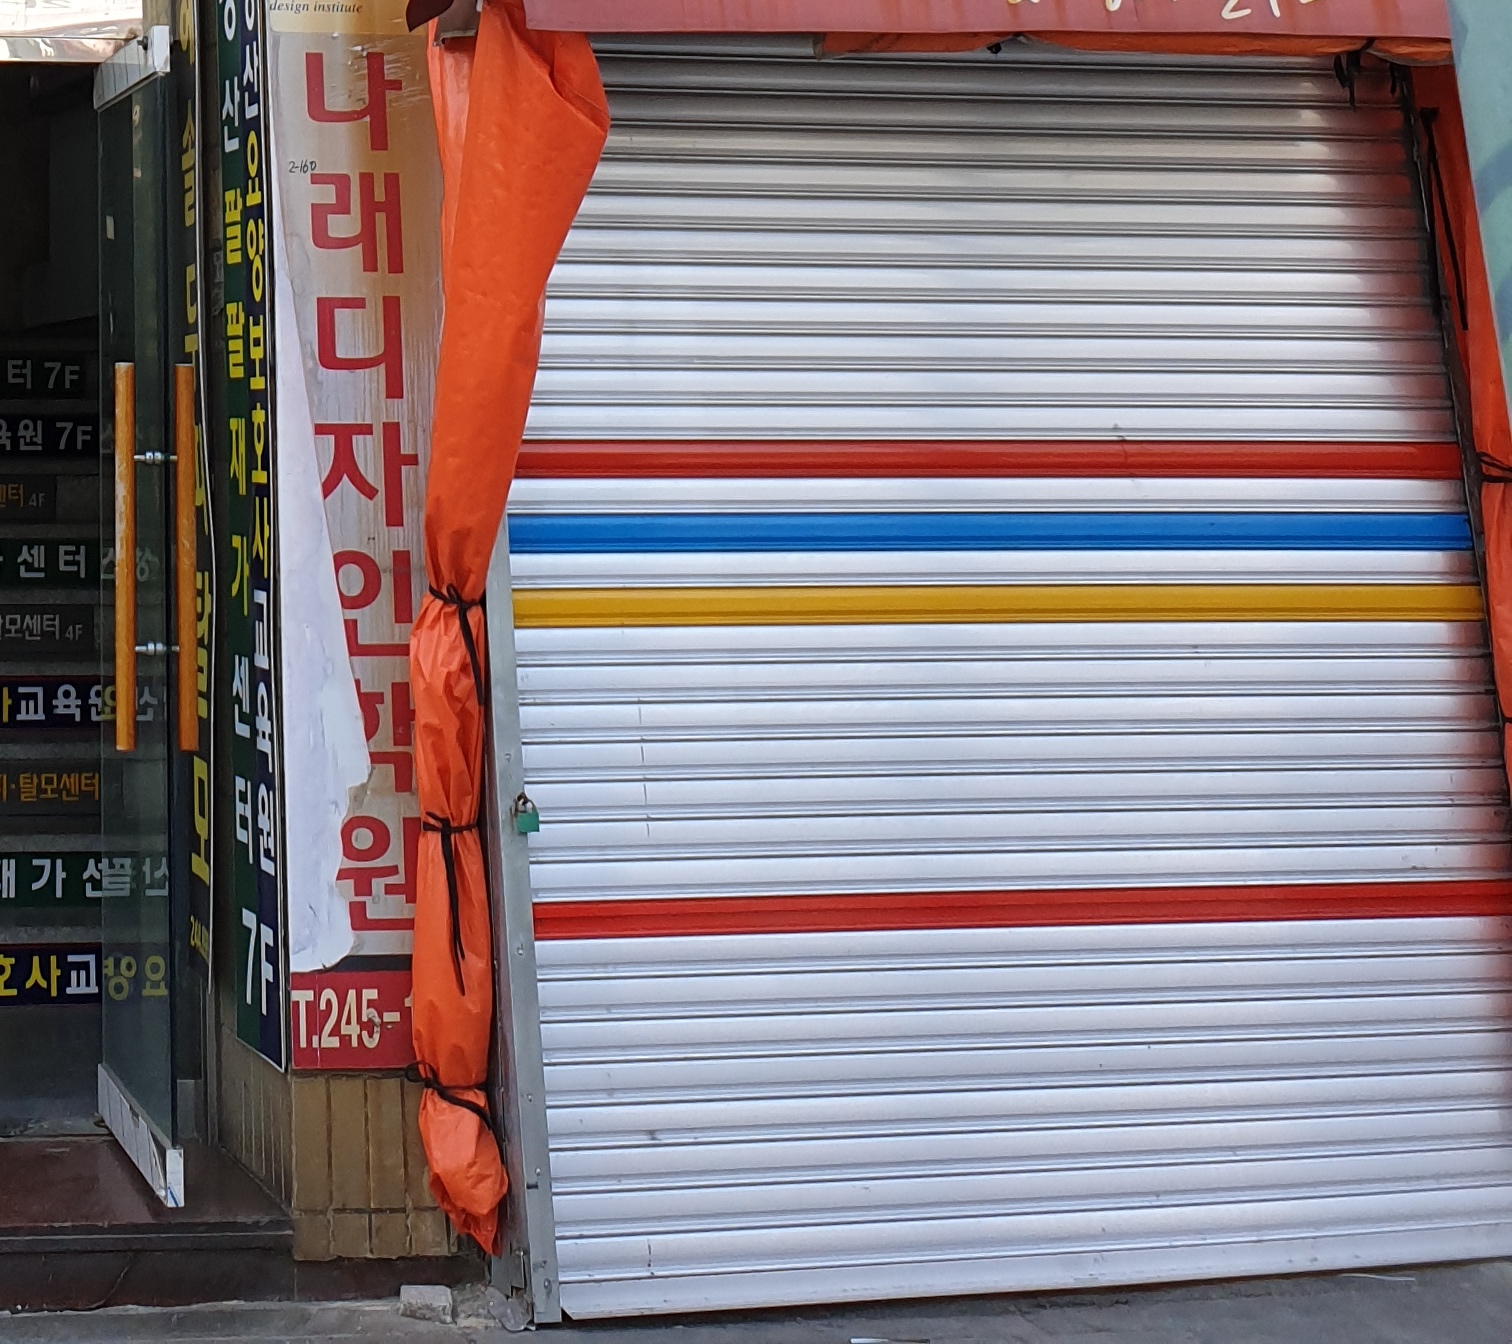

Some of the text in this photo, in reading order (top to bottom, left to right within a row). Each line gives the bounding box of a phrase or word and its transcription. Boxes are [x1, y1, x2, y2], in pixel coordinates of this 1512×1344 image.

[269, 0, 363, 14] design institute
[44, 361, 80, 389] 7F
[56, 421, 92, 451] 7F
[28, 493, 47, 507] 4F
[65, 624, 83, 642] 4F
[242, 908, 274, 1015] 7F
[291, 988, 413, 1049] T.245-
